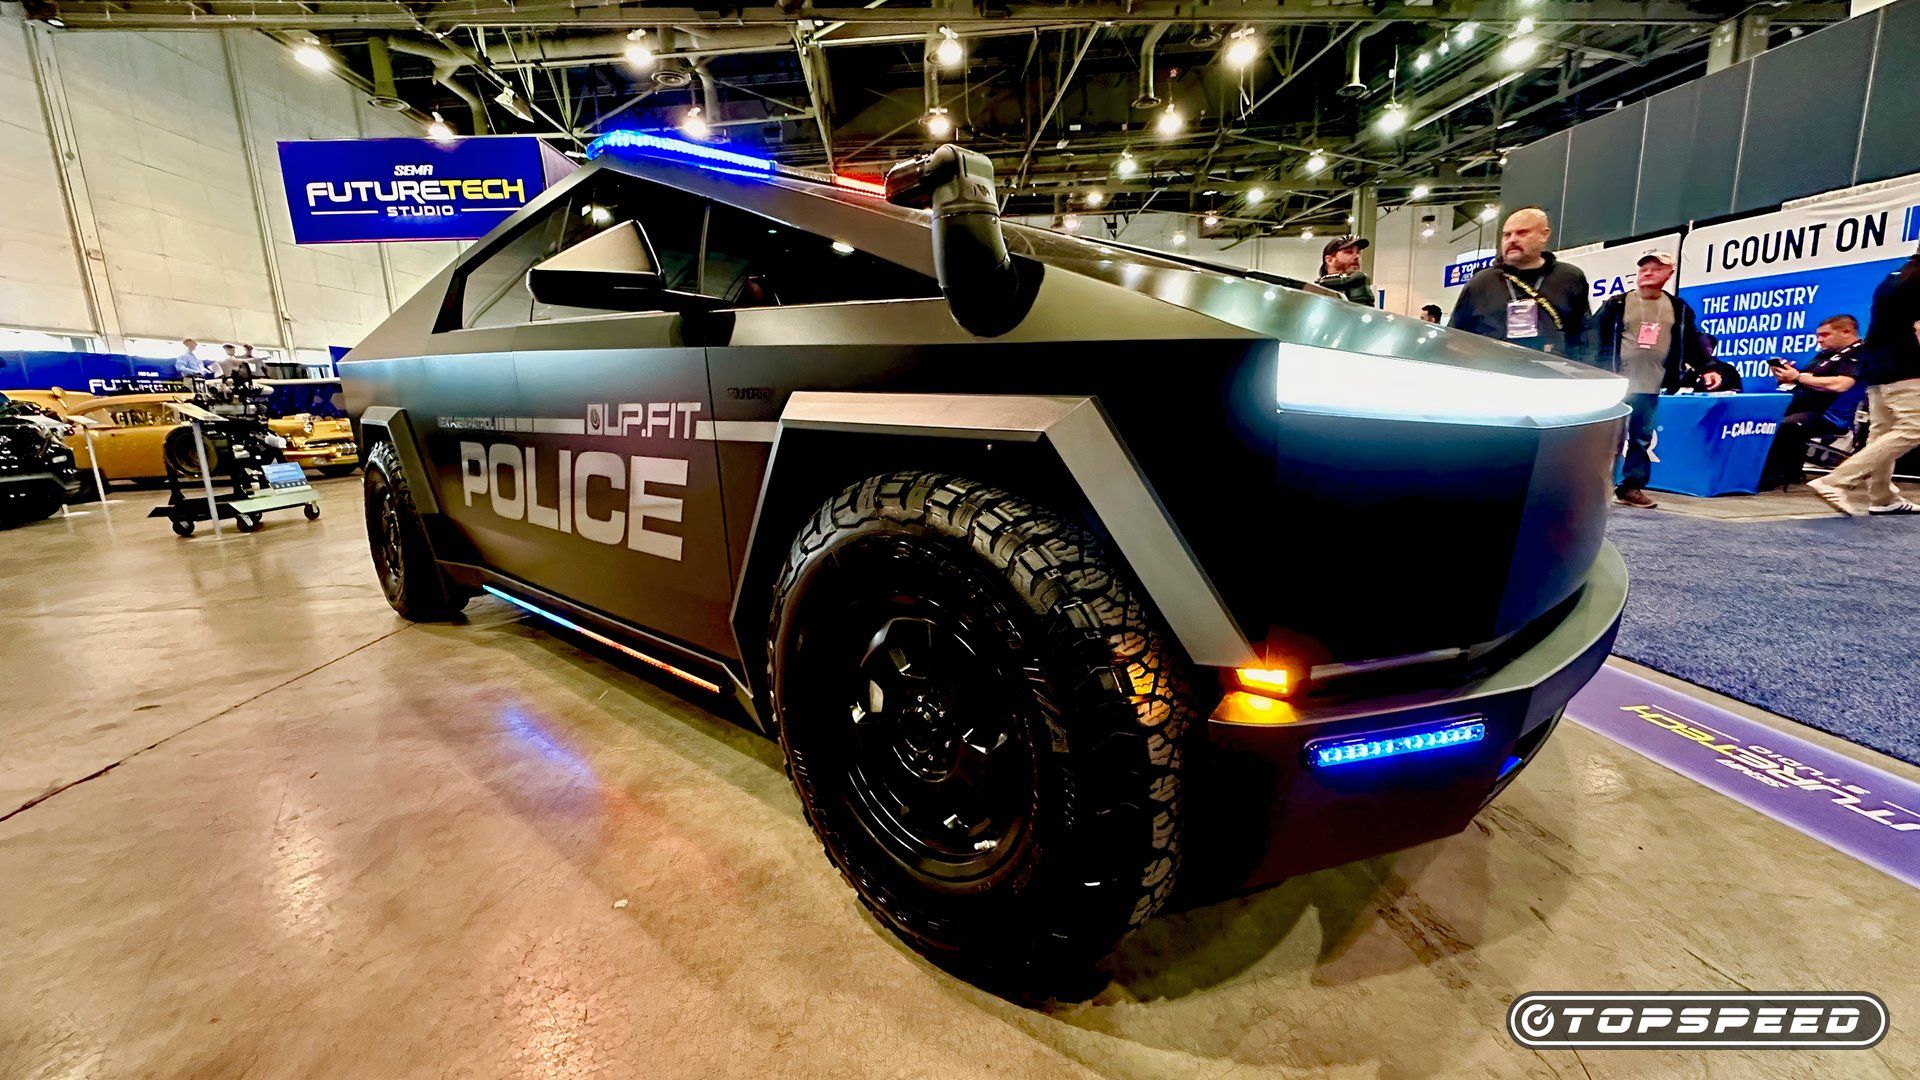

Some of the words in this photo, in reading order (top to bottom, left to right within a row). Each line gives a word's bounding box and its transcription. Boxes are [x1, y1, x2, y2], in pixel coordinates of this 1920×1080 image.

[394, 164, 434, 176] SEMA
[306, 178, 526, 207] FUTURETECH
[387, 205, 454, 217] STUDIO
[1706, 244, 1714, 273] I
[1722, 223, 1827, 270] COUNT
[1836, 211, 1888, 252] ON
[1703, 295, 1730, 315] THE
[1733, 285, 1819, 312] INDUSTRY
[1700, 313, 1782, 336] STANDARD
[1786, 311, 1806, 330] IN
[1711, 336, 1777, 357] LLISION
[459, 441, 689, 562] POLICE
[1748, 745, 1871, 794] STUDIO
